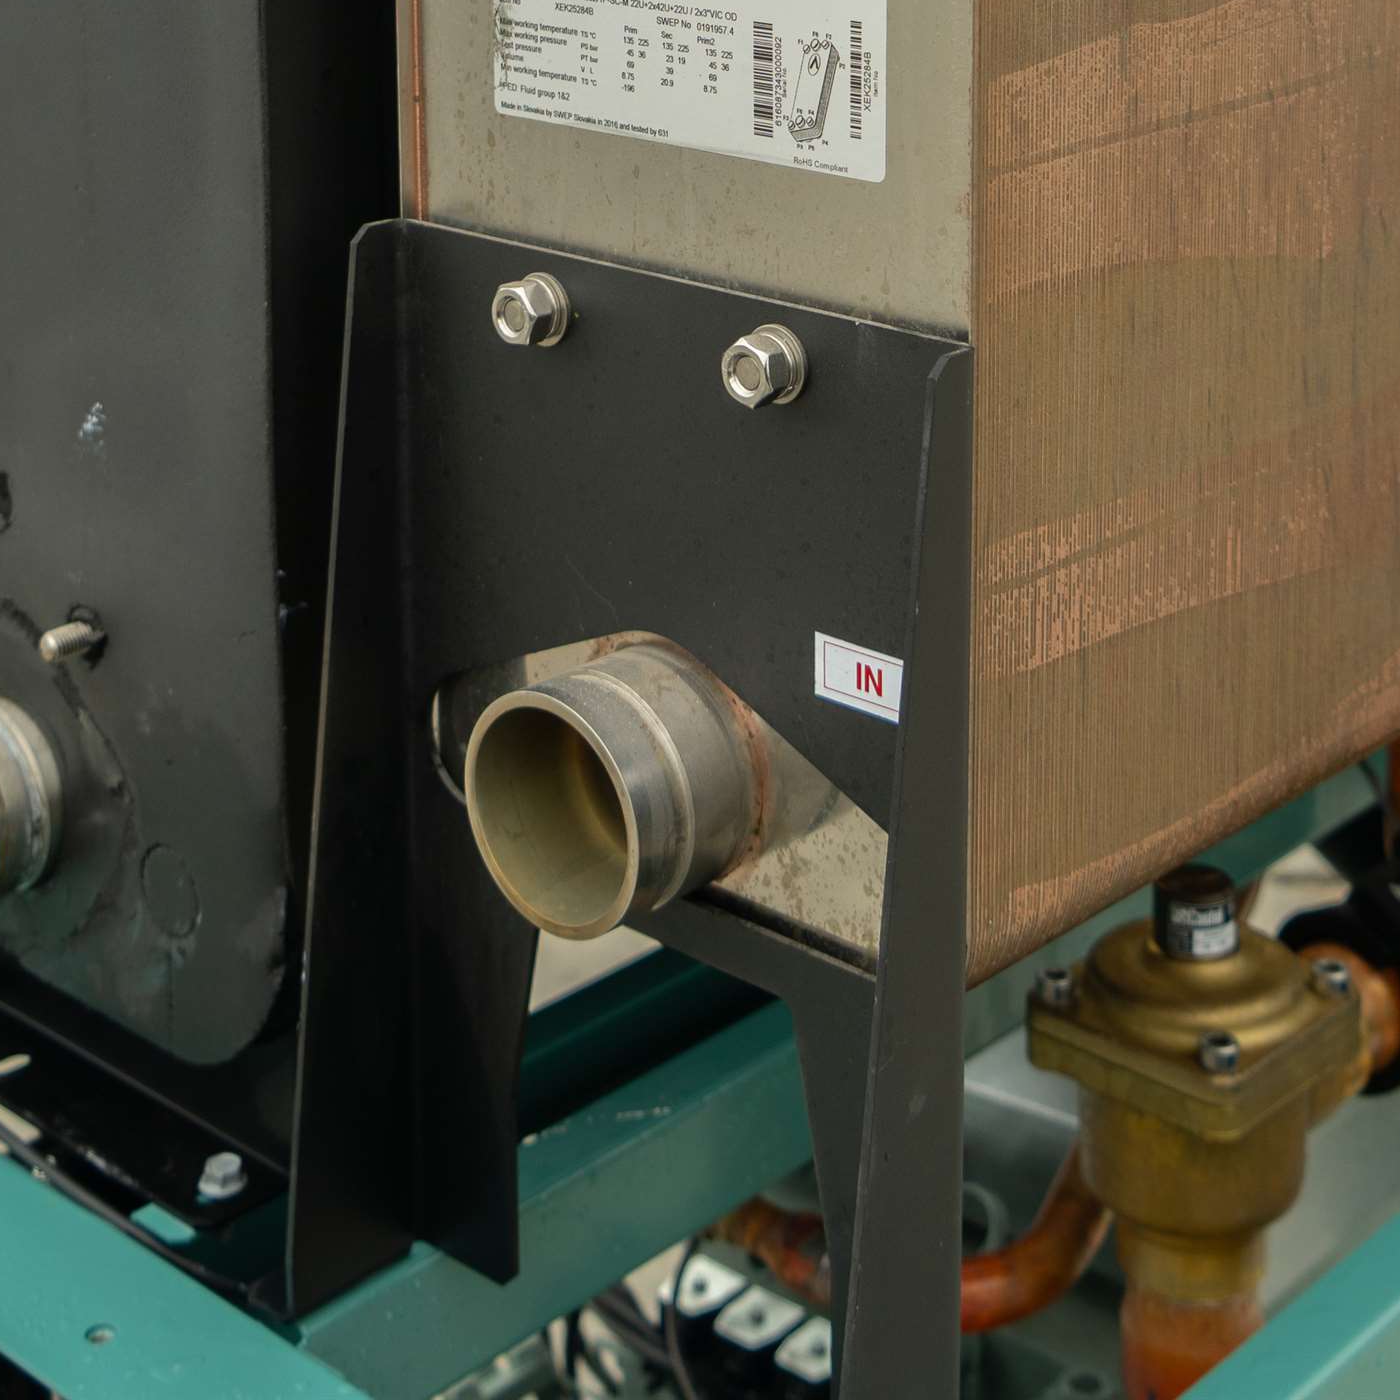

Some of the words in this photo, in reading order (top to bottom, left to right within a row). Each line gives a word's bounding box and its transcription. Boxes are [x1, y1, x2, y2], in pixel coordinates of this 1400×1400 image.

[554, 2, 594, 15] XEK25284B
[724, 11, 738, 22] OD
[623, 25, 637, 34] Prim
[661, 31, 673, 40] Sec
[696, 36, 715, 46] Prim2
[656, 16, 679, 27] SWEP
[681, 19, 692, 29] No
[696, 22, 734, 35] 0191957.4
[514, 21, 539, 32] working
[539, 23, 579, 37] temperature
[662, 42, 673, 51] 135
[677, 44, 689, 53] 225
[705, 48, 717, 57] 135
[721, 51, 733, 60] 225
[514, 31, 539, 43] working
[539, 36, 567, 46] pressure
[665, 55, 673, 63] 23
[678, 57, 686, 65] 19
[708, 62, 717, 70] 45
[721, 63, 729, 72] 36
[514, 42, 542, 53] pressure
[708, 73, 717, 82] 69
[513, 66, 538, 78] working
[538, 69, 577, 83] temperature
[621, 71, 635, 80] 8.75
[660, 78, 674, 87] 20.9
[703, 85, 717, 94] 8.75
[863, 51, 871, 113] XEK25284B
[520, 84, 536, 95] Fluid
[537, 89, 556, 100] group
[557, 91, 570, 101] 1&2
[500, 100, 515, 109] Made
[523, 104, 545, 115] Slovakia
[545, 108, 552, 118] by
[553, 110, 573, 120] SWEP
[573, 113, 596, 124] Slovakia
[597, 117, 602, 126] in
[604, 119, 618, 129] 2016
[619, 123, 630, 131] and
[631, 124, 648, 134] tested
[649, 127, 657, 137] by
[658, 128, 669, 138] 631
[793, 156, 813, 168] RoHS
[814, 159, 849, 174] Compliant
[856, 661, 883, 697] IN
